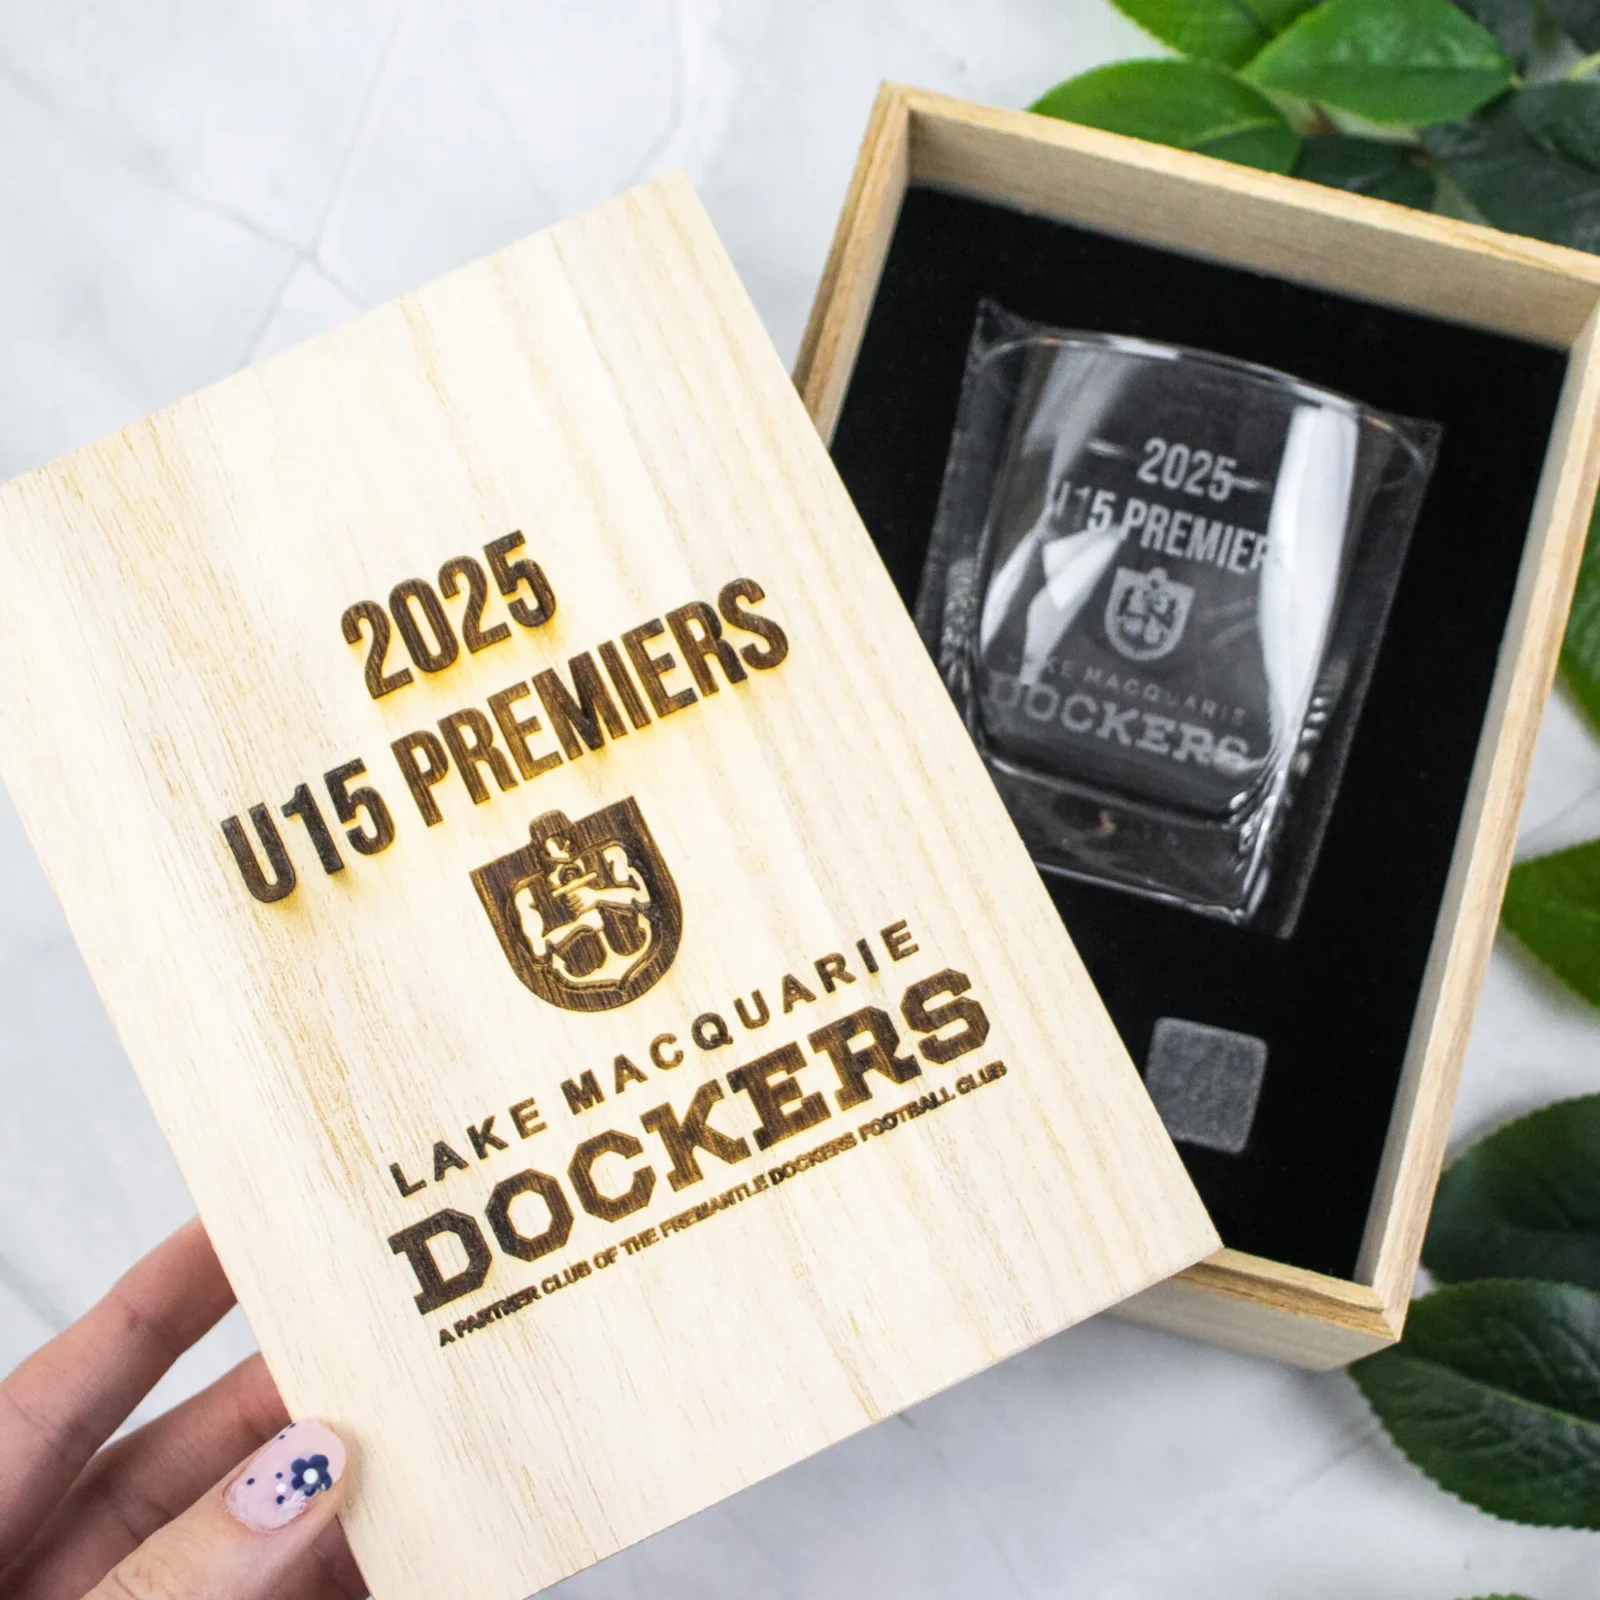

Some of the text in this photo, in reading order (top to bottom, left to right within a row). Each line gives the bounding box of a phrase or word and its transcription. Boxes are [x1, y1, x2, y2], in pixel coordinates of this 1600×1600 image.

[1136, 437, 1238, 502] 2025
[220, 578, 789, 904] U15 PREMIERS
[341, 530, 557, 700] 2025
[387, 968, 991, 1316] DOCKERS
[389, 919, 920, 1198] LAKE MACQUARIE
[438, 1060, 1008, 1348] A PARTNER CLUB OF THE FREMANTLE DOCKERS FOOTBALL CLUB
